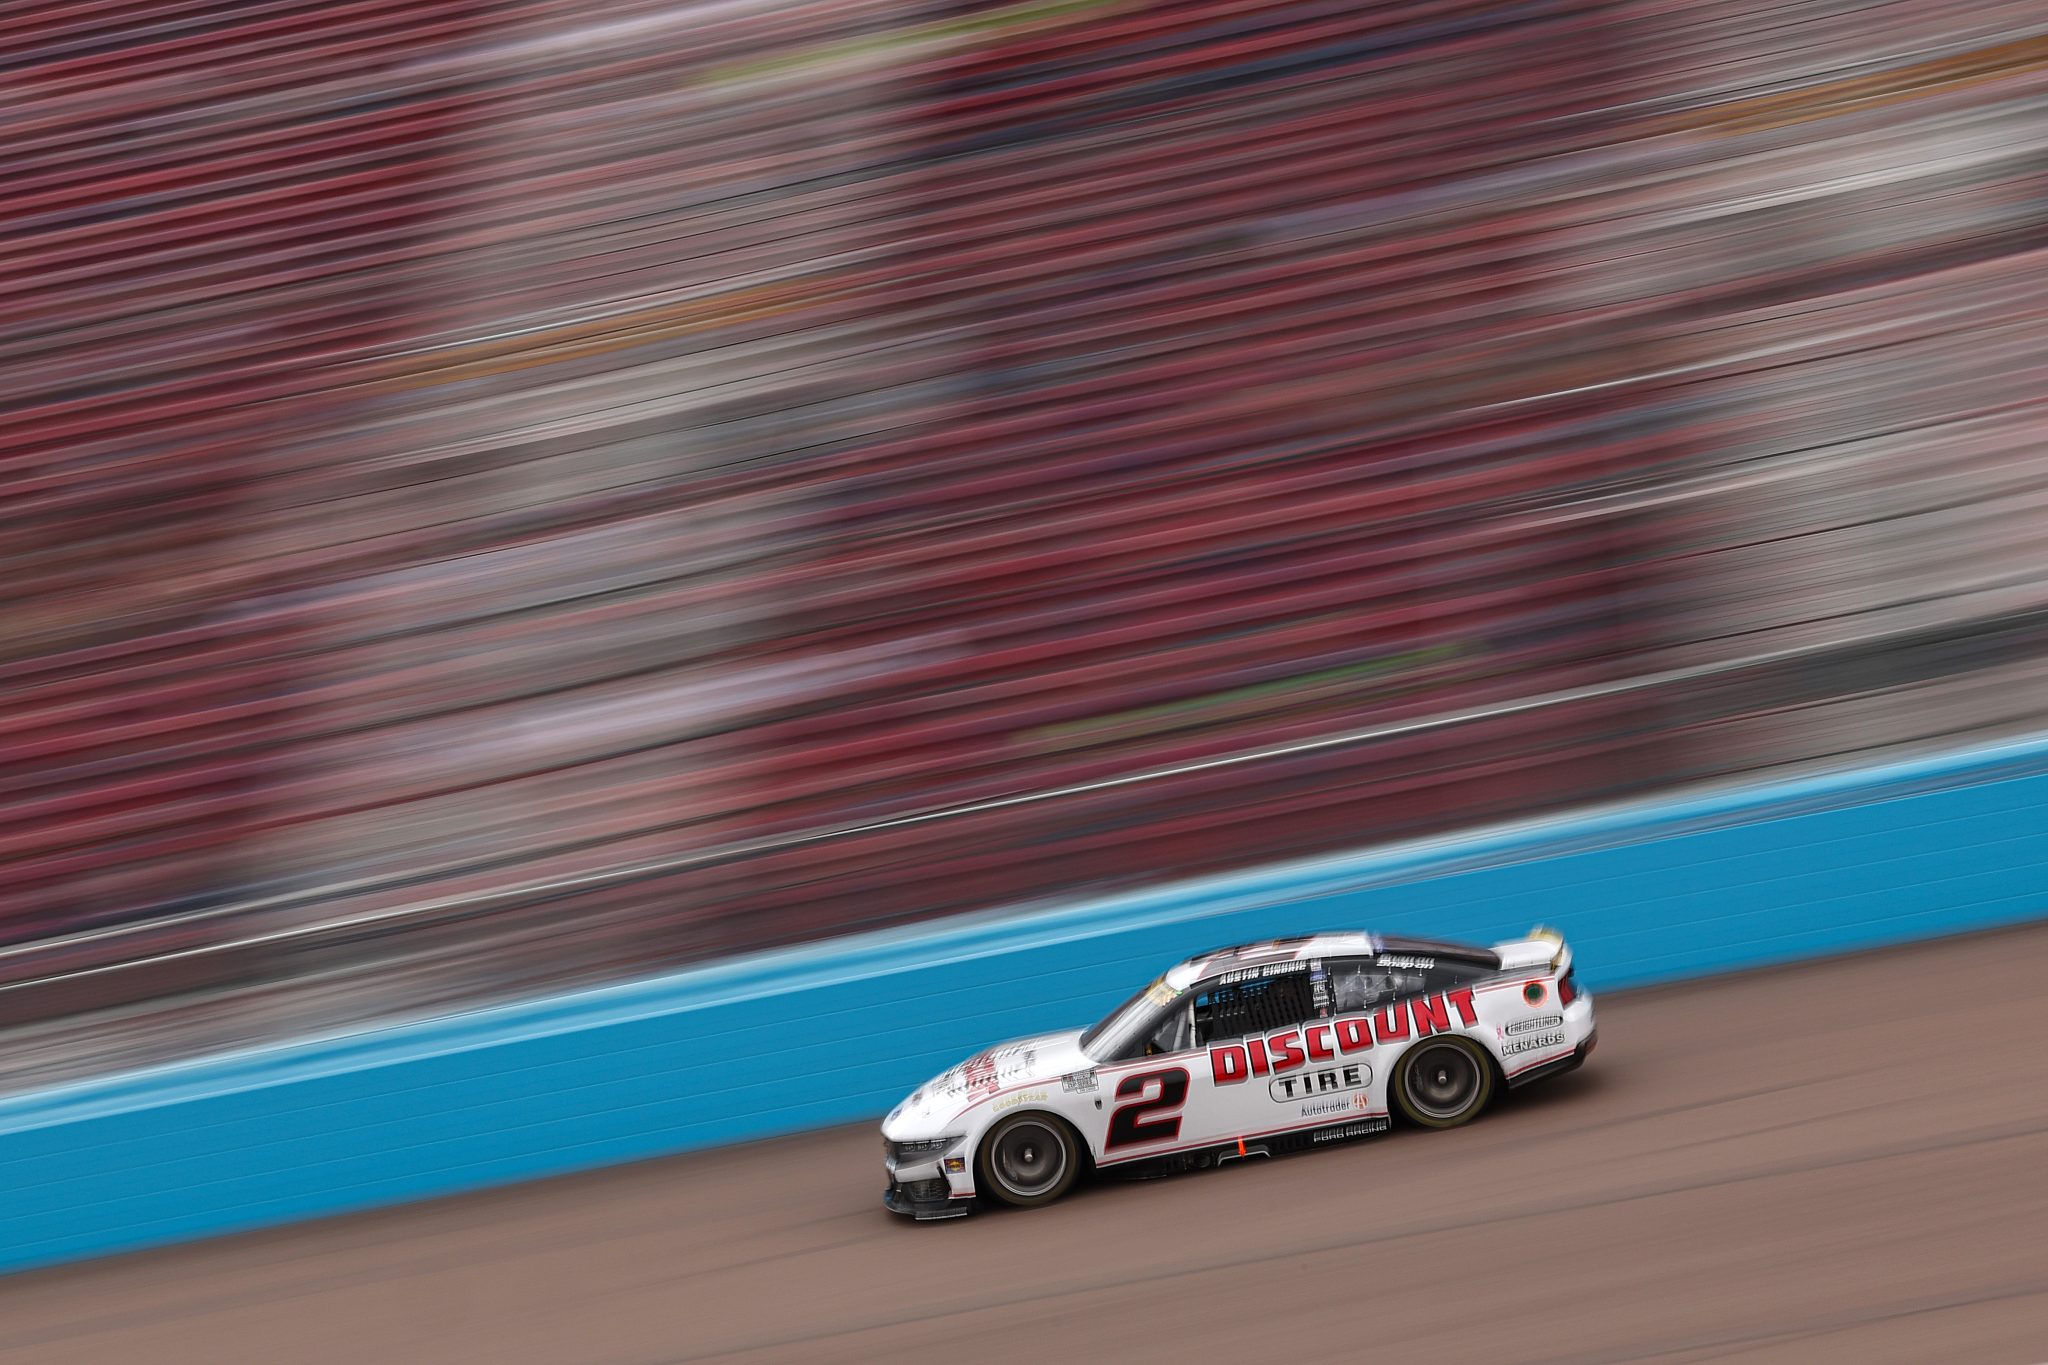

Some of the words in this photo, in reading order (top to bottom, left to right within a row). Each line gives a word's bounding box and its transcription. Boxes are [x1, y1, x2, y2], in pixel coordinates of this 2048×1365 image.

[1219, 968, 1260, 985] AUSTIN
[1262, 961, 1307, 977] CINDRIC
[1376, 955, 1435, 969] Snap-on
[1509, 1017, 1560, 1034] FREIGHTLINER
[1208, 988, 1479, 1086] DISCOUNT
[1502, 1034, 1565, 1056] MENARDS
[1278, 1066, 1363, 1098] TIRE
[1104, 1066, 1191, 1154] 2
[1301, 1099, 1350, 1118] Autotrader
[1313, 1130, 1345, 1142] FORD
[1345, 1122, 1388, 1137] RACING
